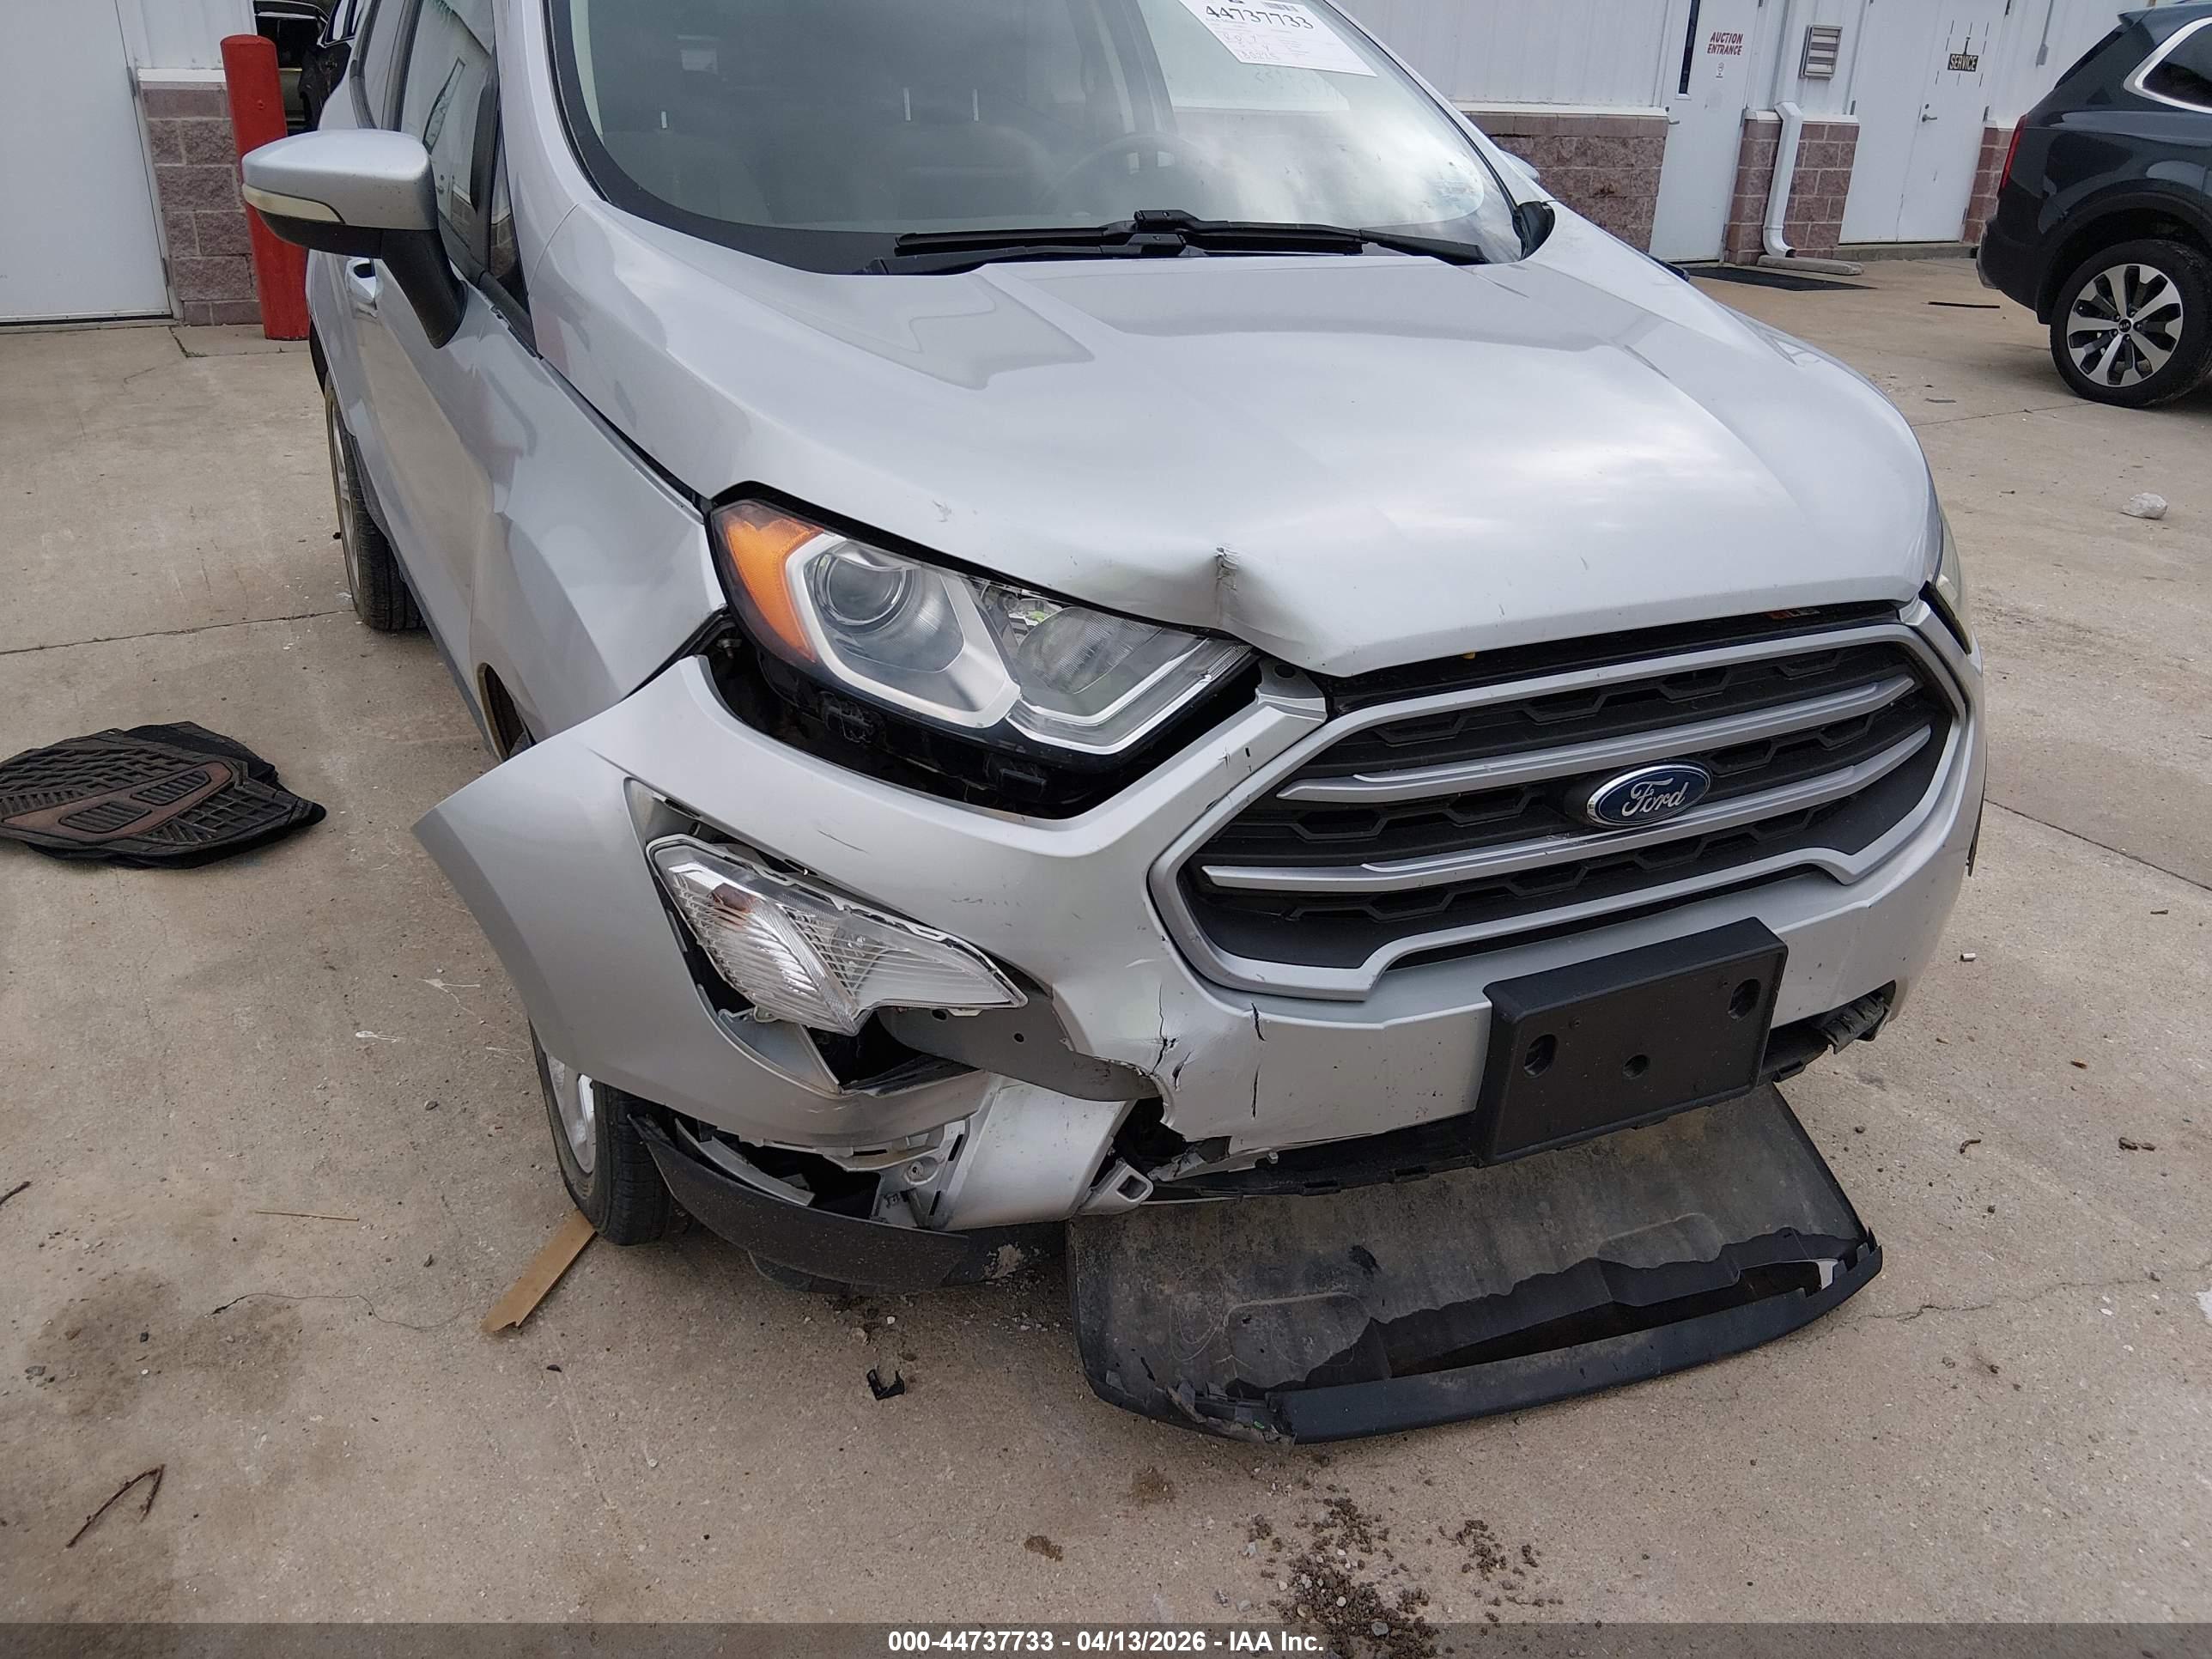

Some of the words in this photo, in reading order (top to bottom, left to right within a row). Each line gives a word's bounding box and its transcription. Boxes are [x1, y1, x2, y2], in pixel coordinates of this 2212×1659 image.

[1206, 6, 1313, 29] 44737733
[1710, 32, 1743, 44] AUCTION
[1707, 44, 1742, 55] ENTRANCE
[1950, 54, 1977, 70] SERVICE
[1621, 777, 1689, 817] Ford
